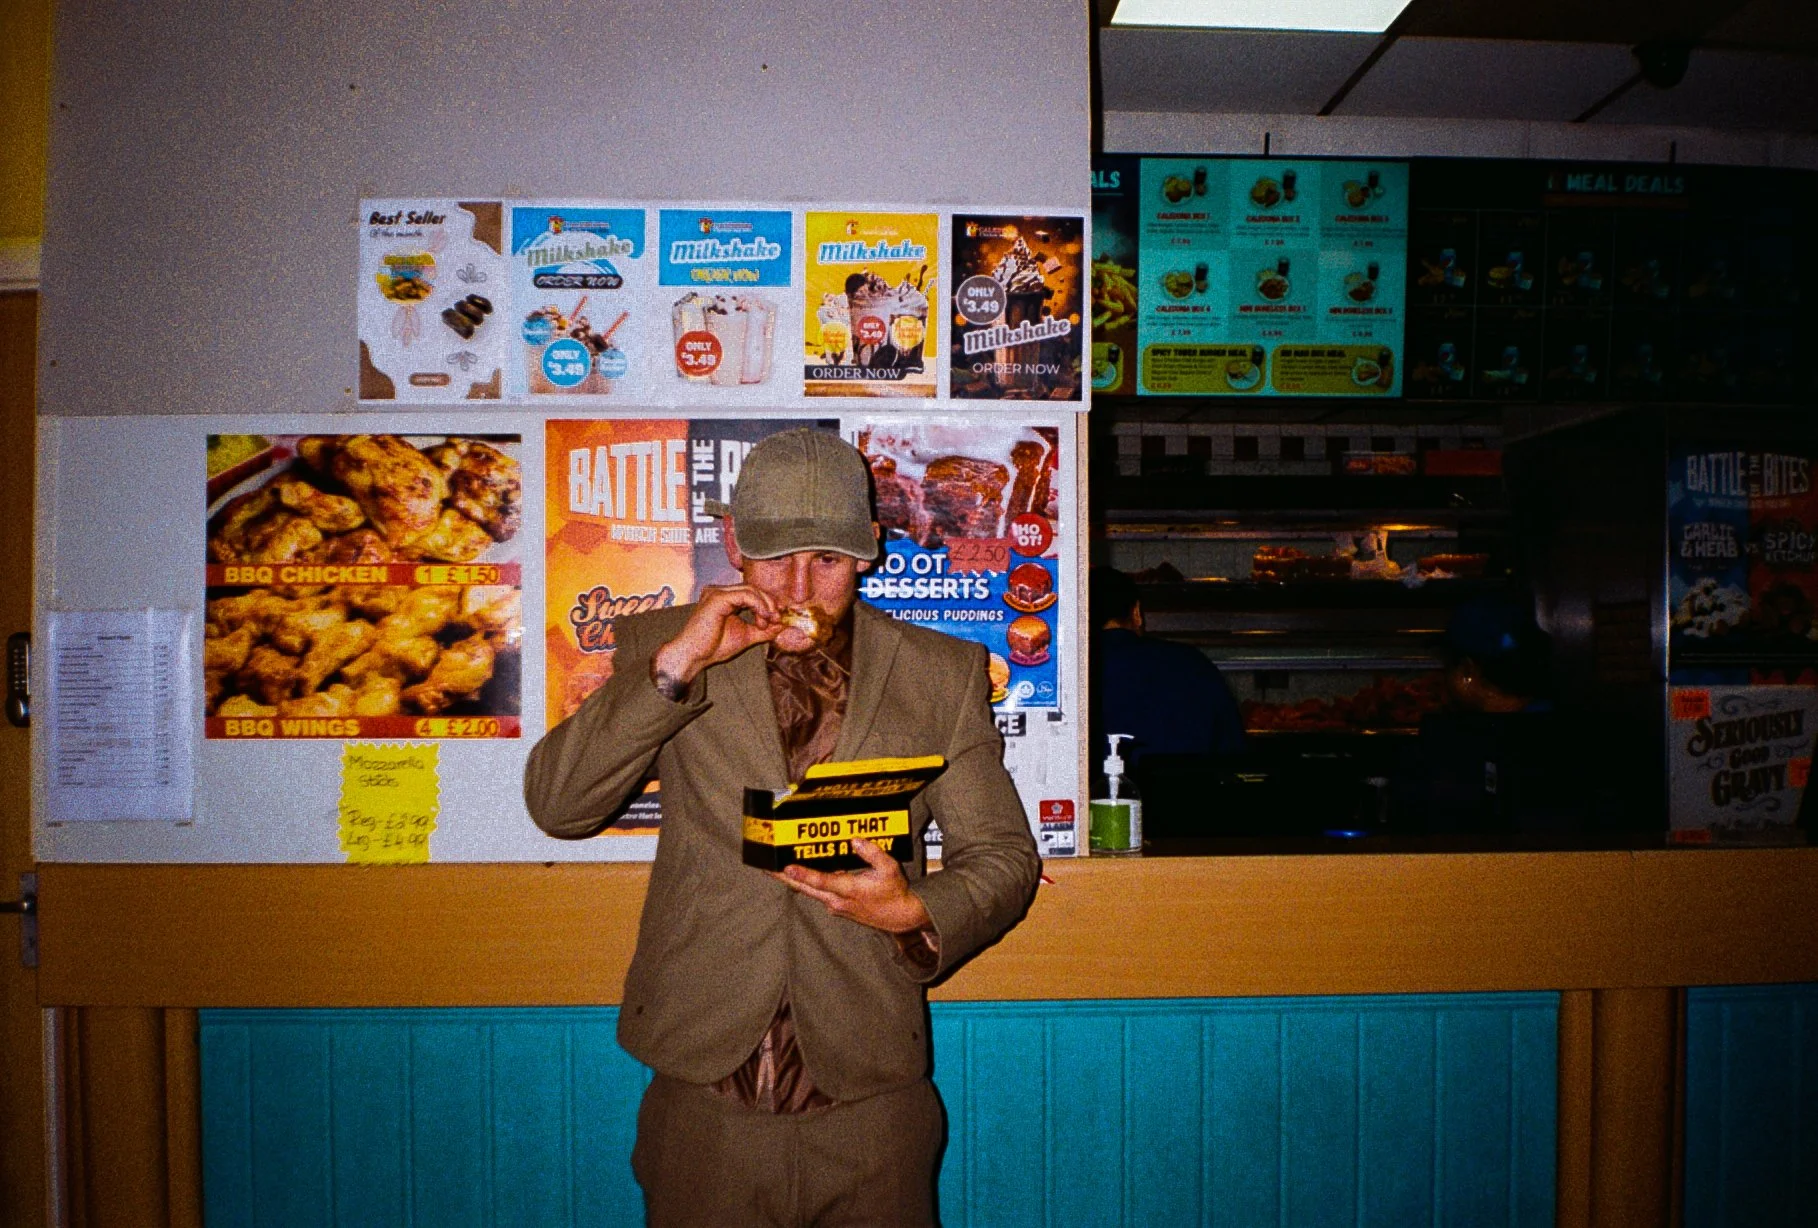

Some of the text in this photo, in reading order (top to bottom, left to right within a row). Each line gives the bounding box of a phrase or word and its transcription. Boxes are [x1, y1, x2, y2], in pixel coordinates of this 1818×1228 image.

[1567, 174, 1617, 192] MEAL
[1625, 174, 1684, 193] DEALS
[370, 210, 446, 225] Best Seller
[526, 236, 632, 267] Milkshake
[671, 238, 780, 262] Milkshake
[818, 240, 925, 262] Milkshake
[536, 275, 620, 287] ORDER NOW
[967, 286, 995, 298] ONLY
[963, 300, 1000, 313] £3.49
[964, 316, 1072, 354] Milkshake
[551, 350, 580, 360] ONLY
[685, 341, 712, 352] ONLY
[813, 368, 900, 379] ORDER NOW
[972, 362, 1060, 376] ORDER NOW
[569, 438, 686, 522] BATTLE
[692, 438, 715, 486] THE
[1686, 452, 1748, 496] BATTLE
[1763, 453, 1810, 496] BITES
[611, 526, 720, 544] WHICH SIDE ARE
[1018, 524, 1040, 534] HO
[1682, 522, 1734, 540] GARLIC
[1018, 536, 1042, 546] OT!
[1695, 542, 1738, 558] HERB
[911, 553, 946, 574] OT
[224, 566, 388, 584] BBQ CHICKEN
[866, 578, 990, 599] DESSERTS
[571, 586, 675, 622] Sweet
[887, 610, 1004, 622] LICIOUS PUDDINGS
[224, 720, 360, 736] BBQ WINGS
[1687, 709, 1804, 757] SERIOUSLY
[348, 755, 424, 770] Mozzarella
[1730, 746, 1770, 768] GOOD
[1712, 766, 1787, 806] GRAVY
[797, 816, 889, 838] FOOD THAT
[794, 843, 835, 860] TELLS
[839, 842, 848, 855] A
